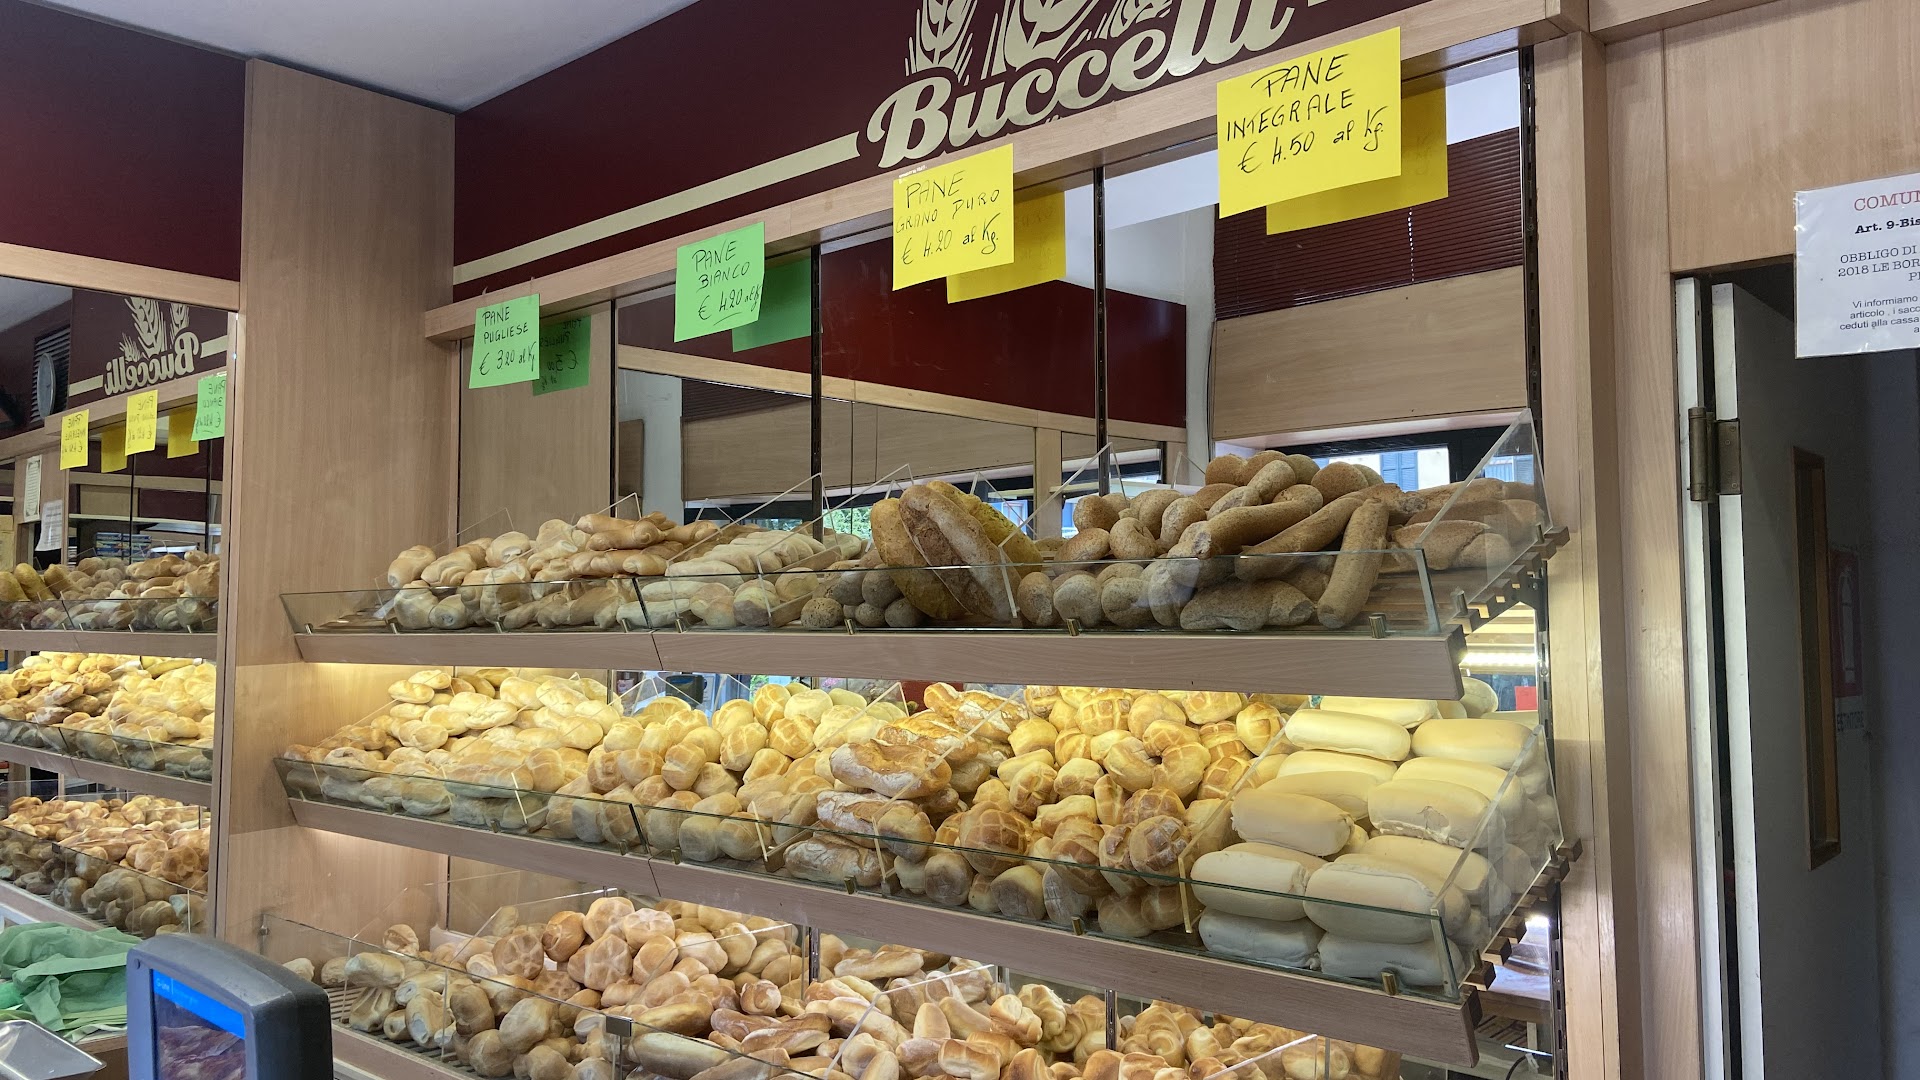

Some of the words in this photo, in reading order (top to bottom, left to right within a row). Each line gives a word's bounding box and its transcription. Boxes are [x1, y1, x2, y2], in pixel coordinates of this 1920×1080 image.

[867, 0, 1294, 168] Buccelli
[1250, 53, 1350, 98] PANE
[1226, 88, 1355, 142] INTEGRALE
[1237, 141, 1262, 174] €
[1272, 131, 1315, 165] 4.50
[1333, 119, 1355, 145] al
[905, 170, 966, 208] PANE
[896, 209, 938, 234] GRANO
[951, 189, 1000, 220] DURO
[1855, 222, 1882, 234] Art.
[1886, 217, 1920, 230] 9-Bis
[691, 239, 737, 273] PANE
[902, 237, 915, 265] €
[923, 229, 953, 258] 4.20
[962, 225, 976, 246] al
[1840, 246, 1899, 264] OBBLIGO
[1902, 245, 1918, 256] DI
[695, 261, 751, 294] BIANCO
[1838, 267, 1869, 277] 2018
[1872, 262, 1890, 273] LE
[697, 294, 711, 321] €
[1850, 308, 1885, 319] articolo
[1852, 300, 1862, 309] Vi
[1864, 295, 1918, 308] informiamo
[482, 306, 510, 327] PANE
[1840, 319, 1869, 331] ceduti
[1871, 319, 1888, 329] alla
[1890, 316, 1920, 326] cassa
[483, 322, 529, 345] PUGLIESE
[479, 352, 490, 375] €
